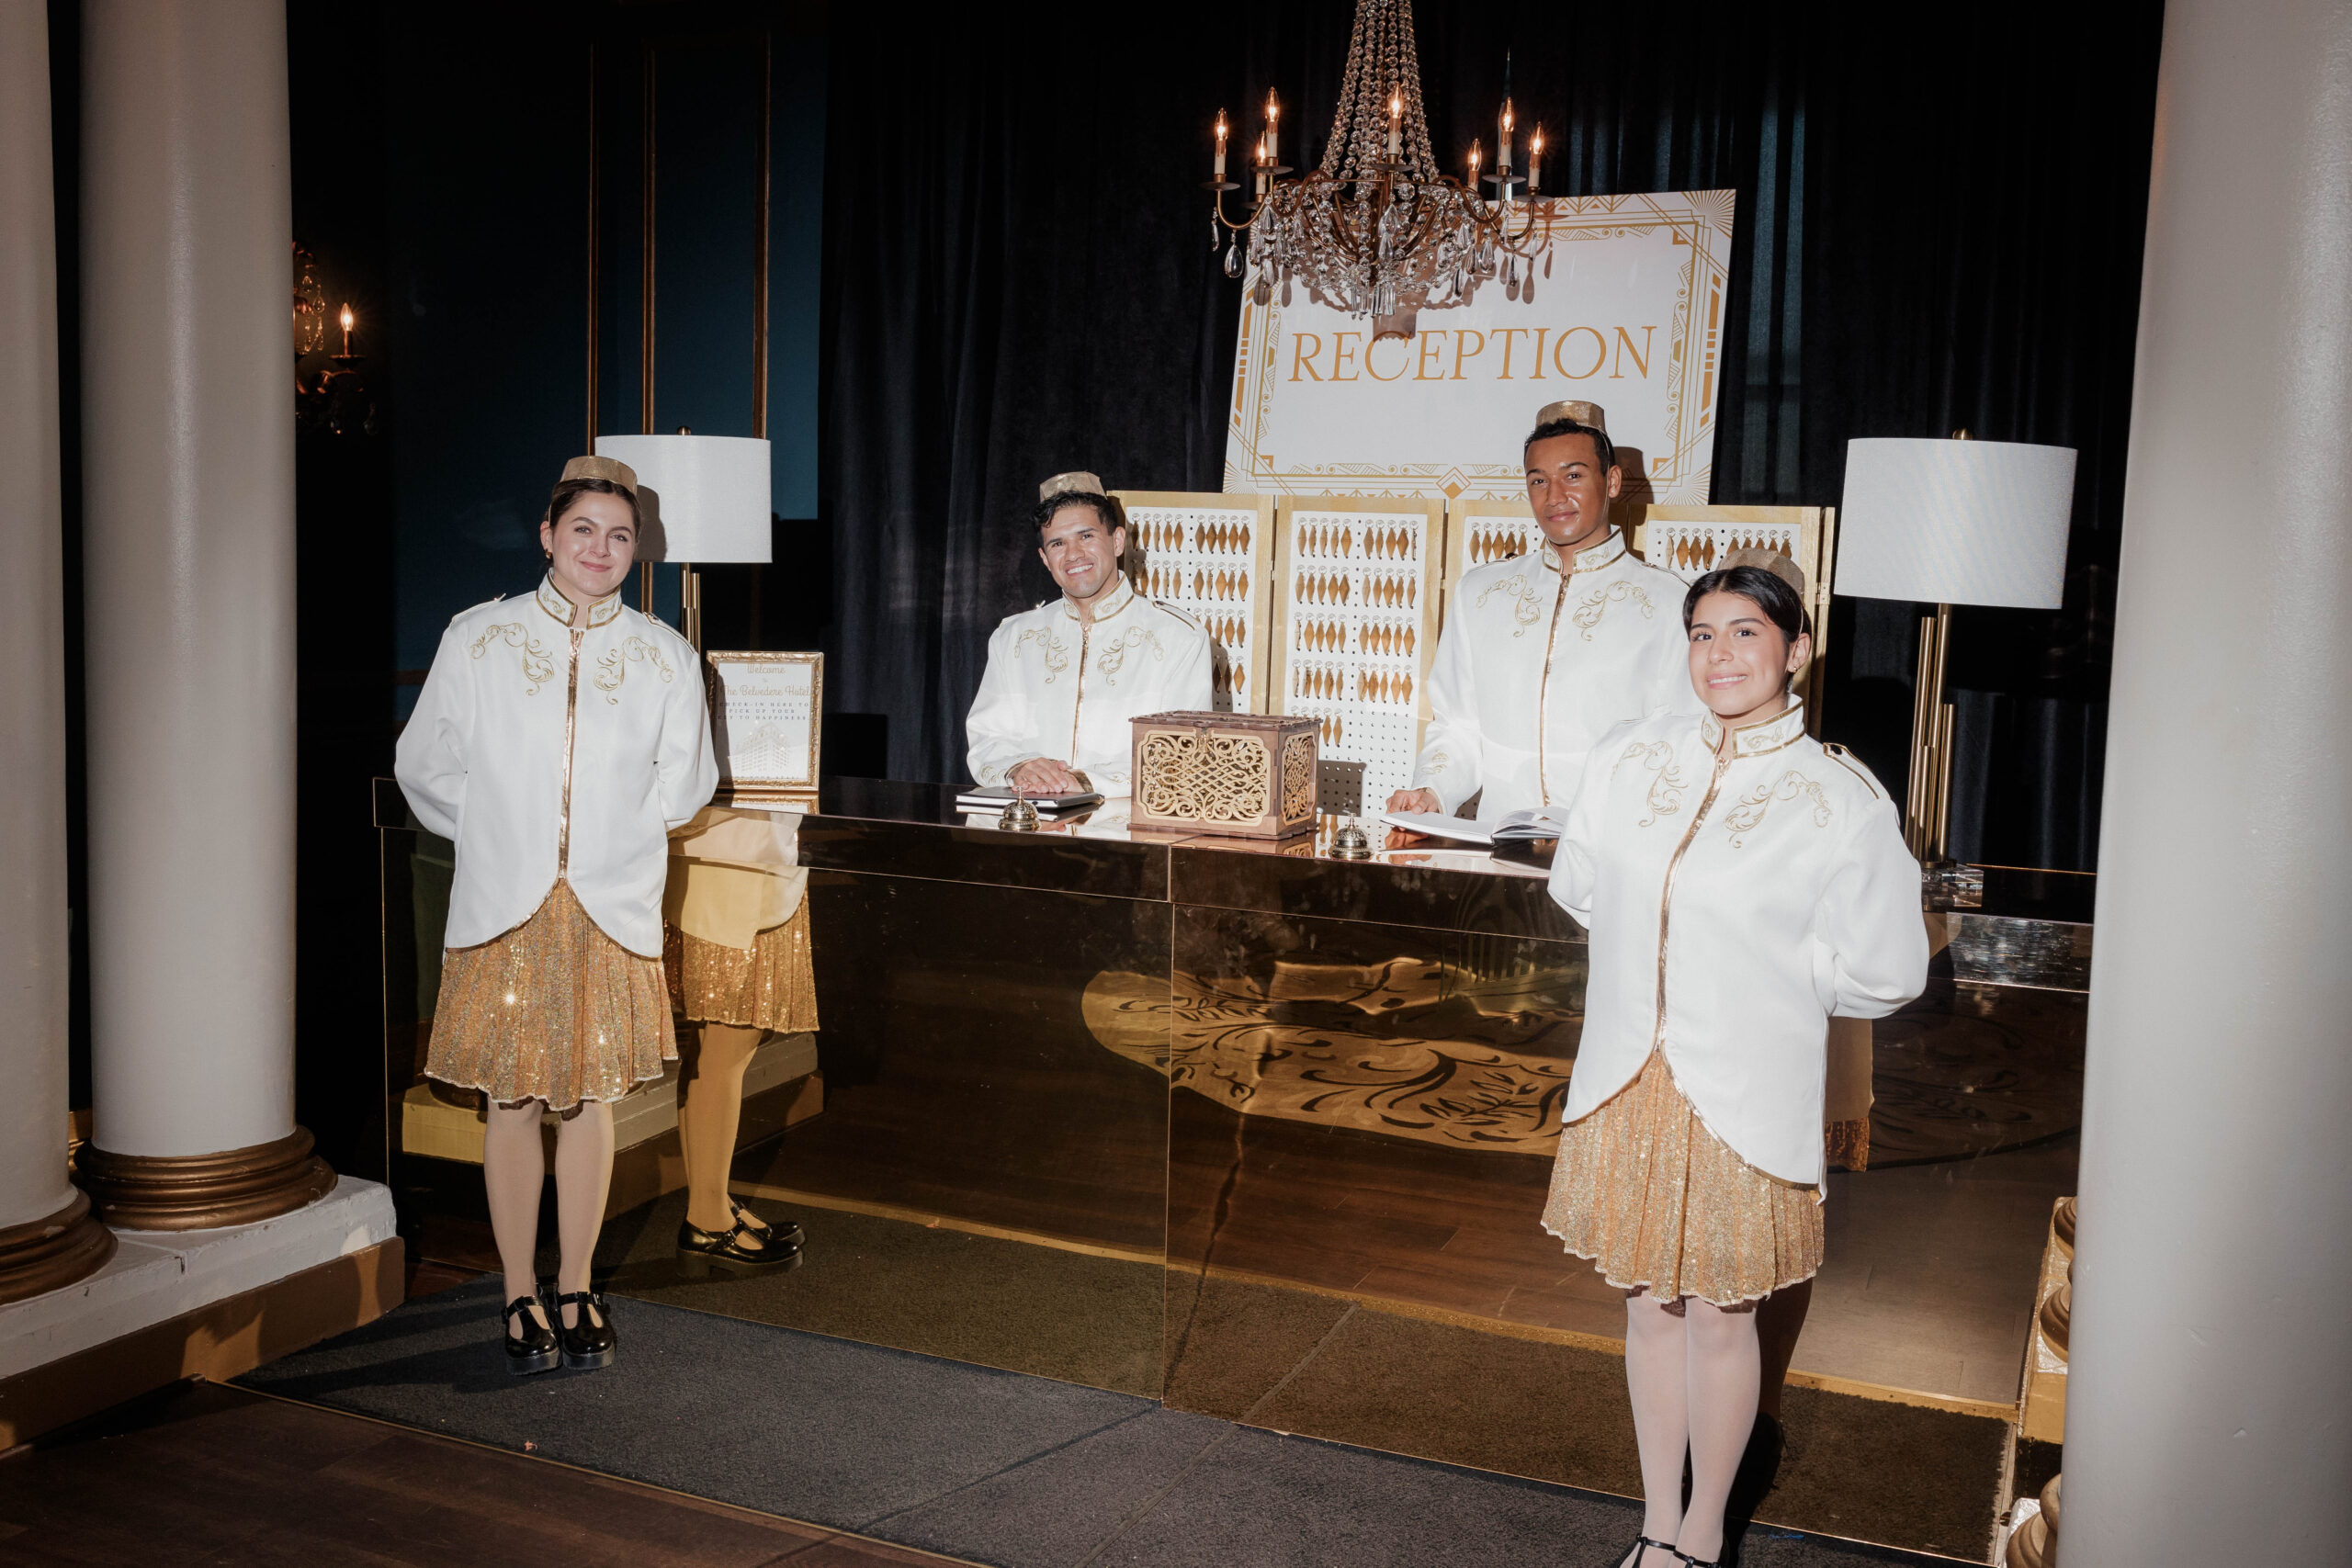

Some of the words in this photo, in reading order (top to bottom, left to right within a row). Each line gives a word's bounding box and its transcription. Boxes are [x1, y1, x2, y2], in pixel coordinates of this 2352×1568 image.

[1288, 326, 1657, 382] RECEPTION
[747, 663, 786, 674] Welcome
[740, 684, 784, 696] Belvedere
[785, 685, 810, 696] Hotel
